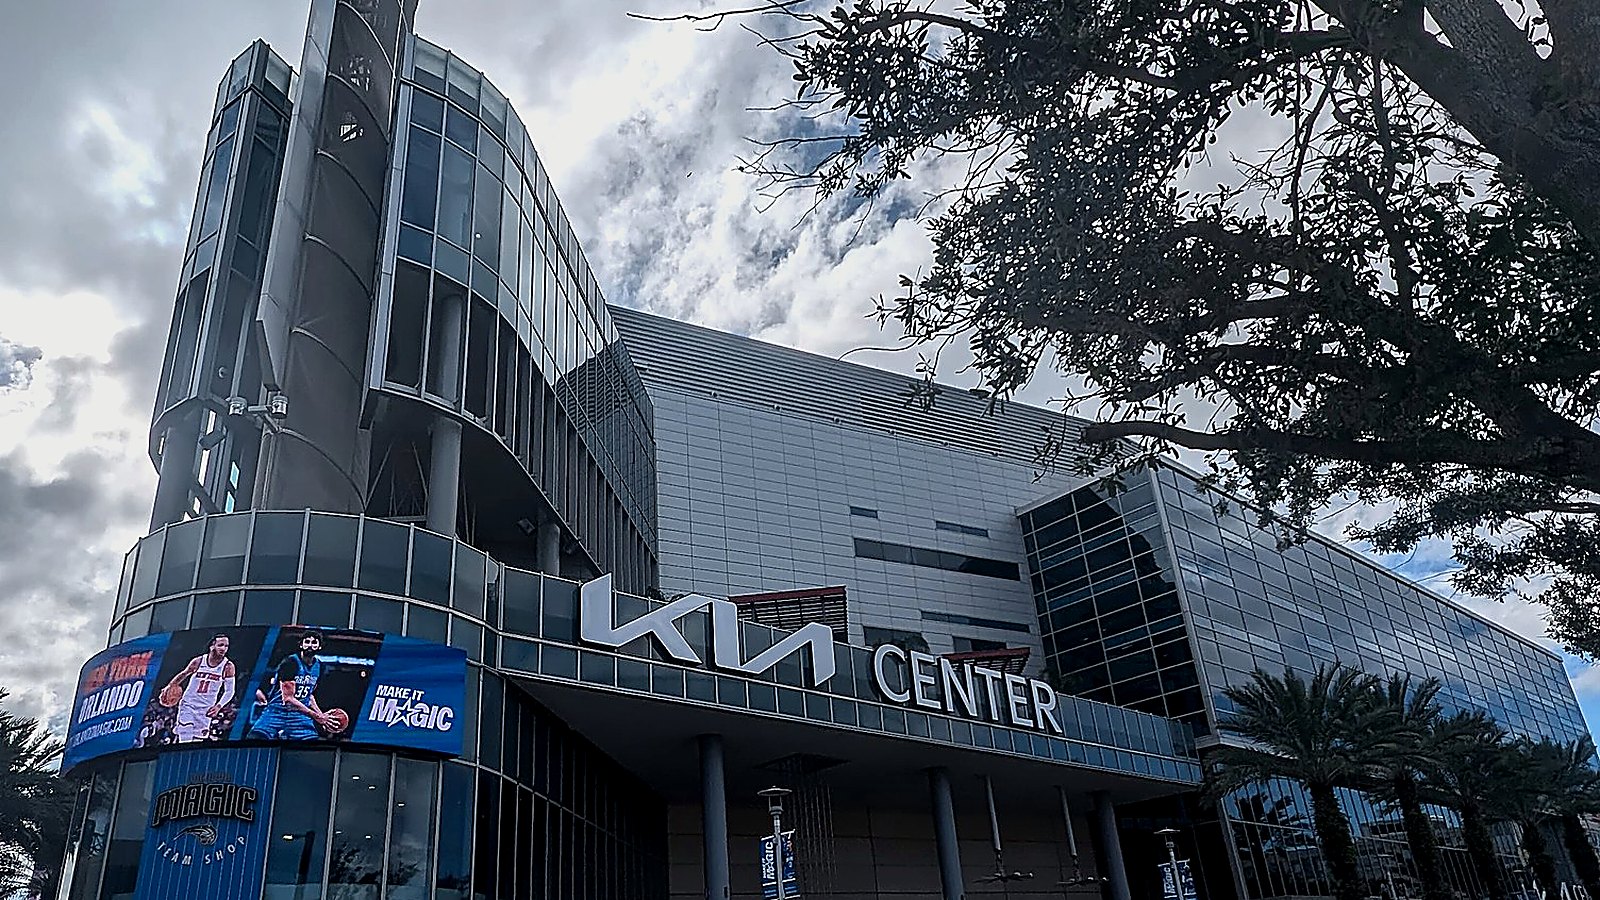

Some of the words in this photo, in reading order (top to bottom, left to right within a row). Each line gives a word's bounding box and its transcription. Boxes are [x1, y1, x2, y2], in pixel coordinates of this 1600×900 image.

[78, 680, 145, 724] ORLANDO
[294, 685, 310, 699] 35
[376, 684, 412, 700] MAKE
[411, 689, 425, 701] IT
[874, 644, 1062, 733] CENTER
[151, 782, 257, 828] MAGIC
[157, 841, 193, 866] TEAM
[204, 836, 246, 865] SHOP
